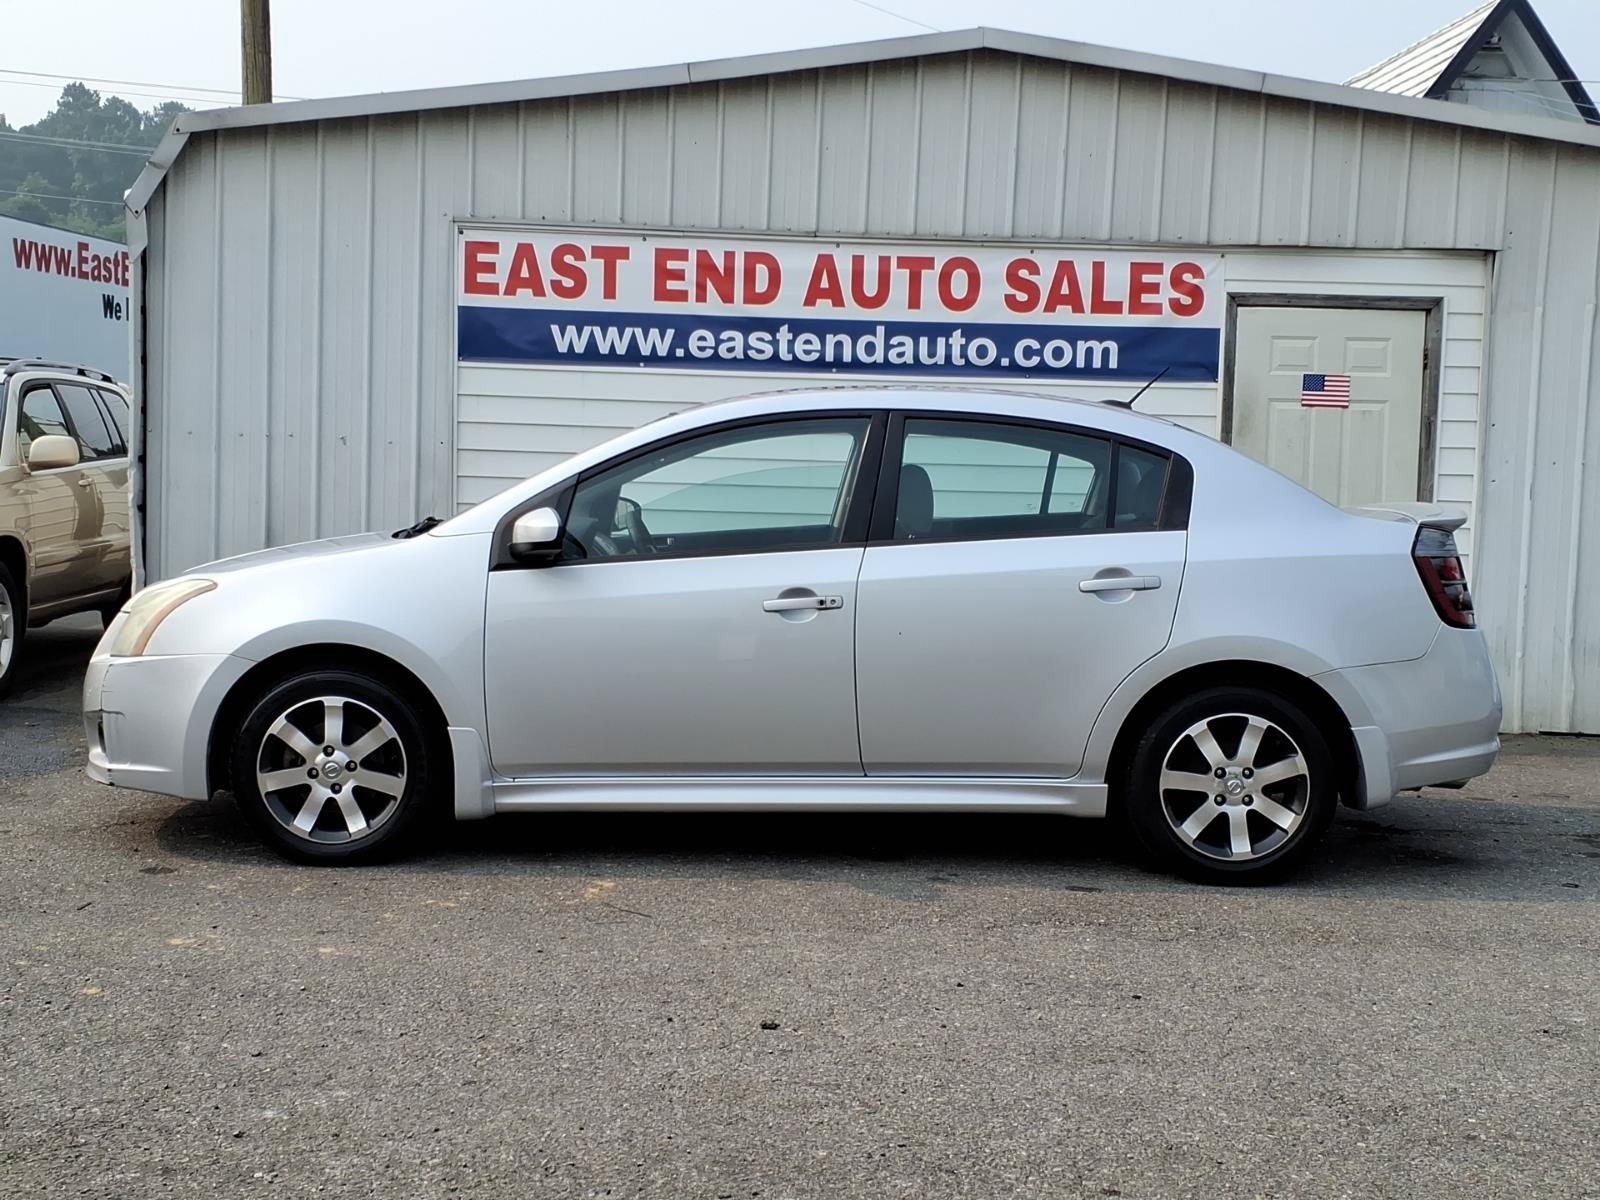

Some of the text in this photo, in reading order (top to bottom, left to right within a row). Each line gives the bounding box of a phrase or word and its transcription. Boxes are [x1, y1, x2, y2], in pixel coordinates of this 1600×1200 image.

[463, 240, 1206, 317] EAST END AUTO SALES
[102, 293, 122, 320] We
[550, 324, 1119, 369] www.eastendauto.com
